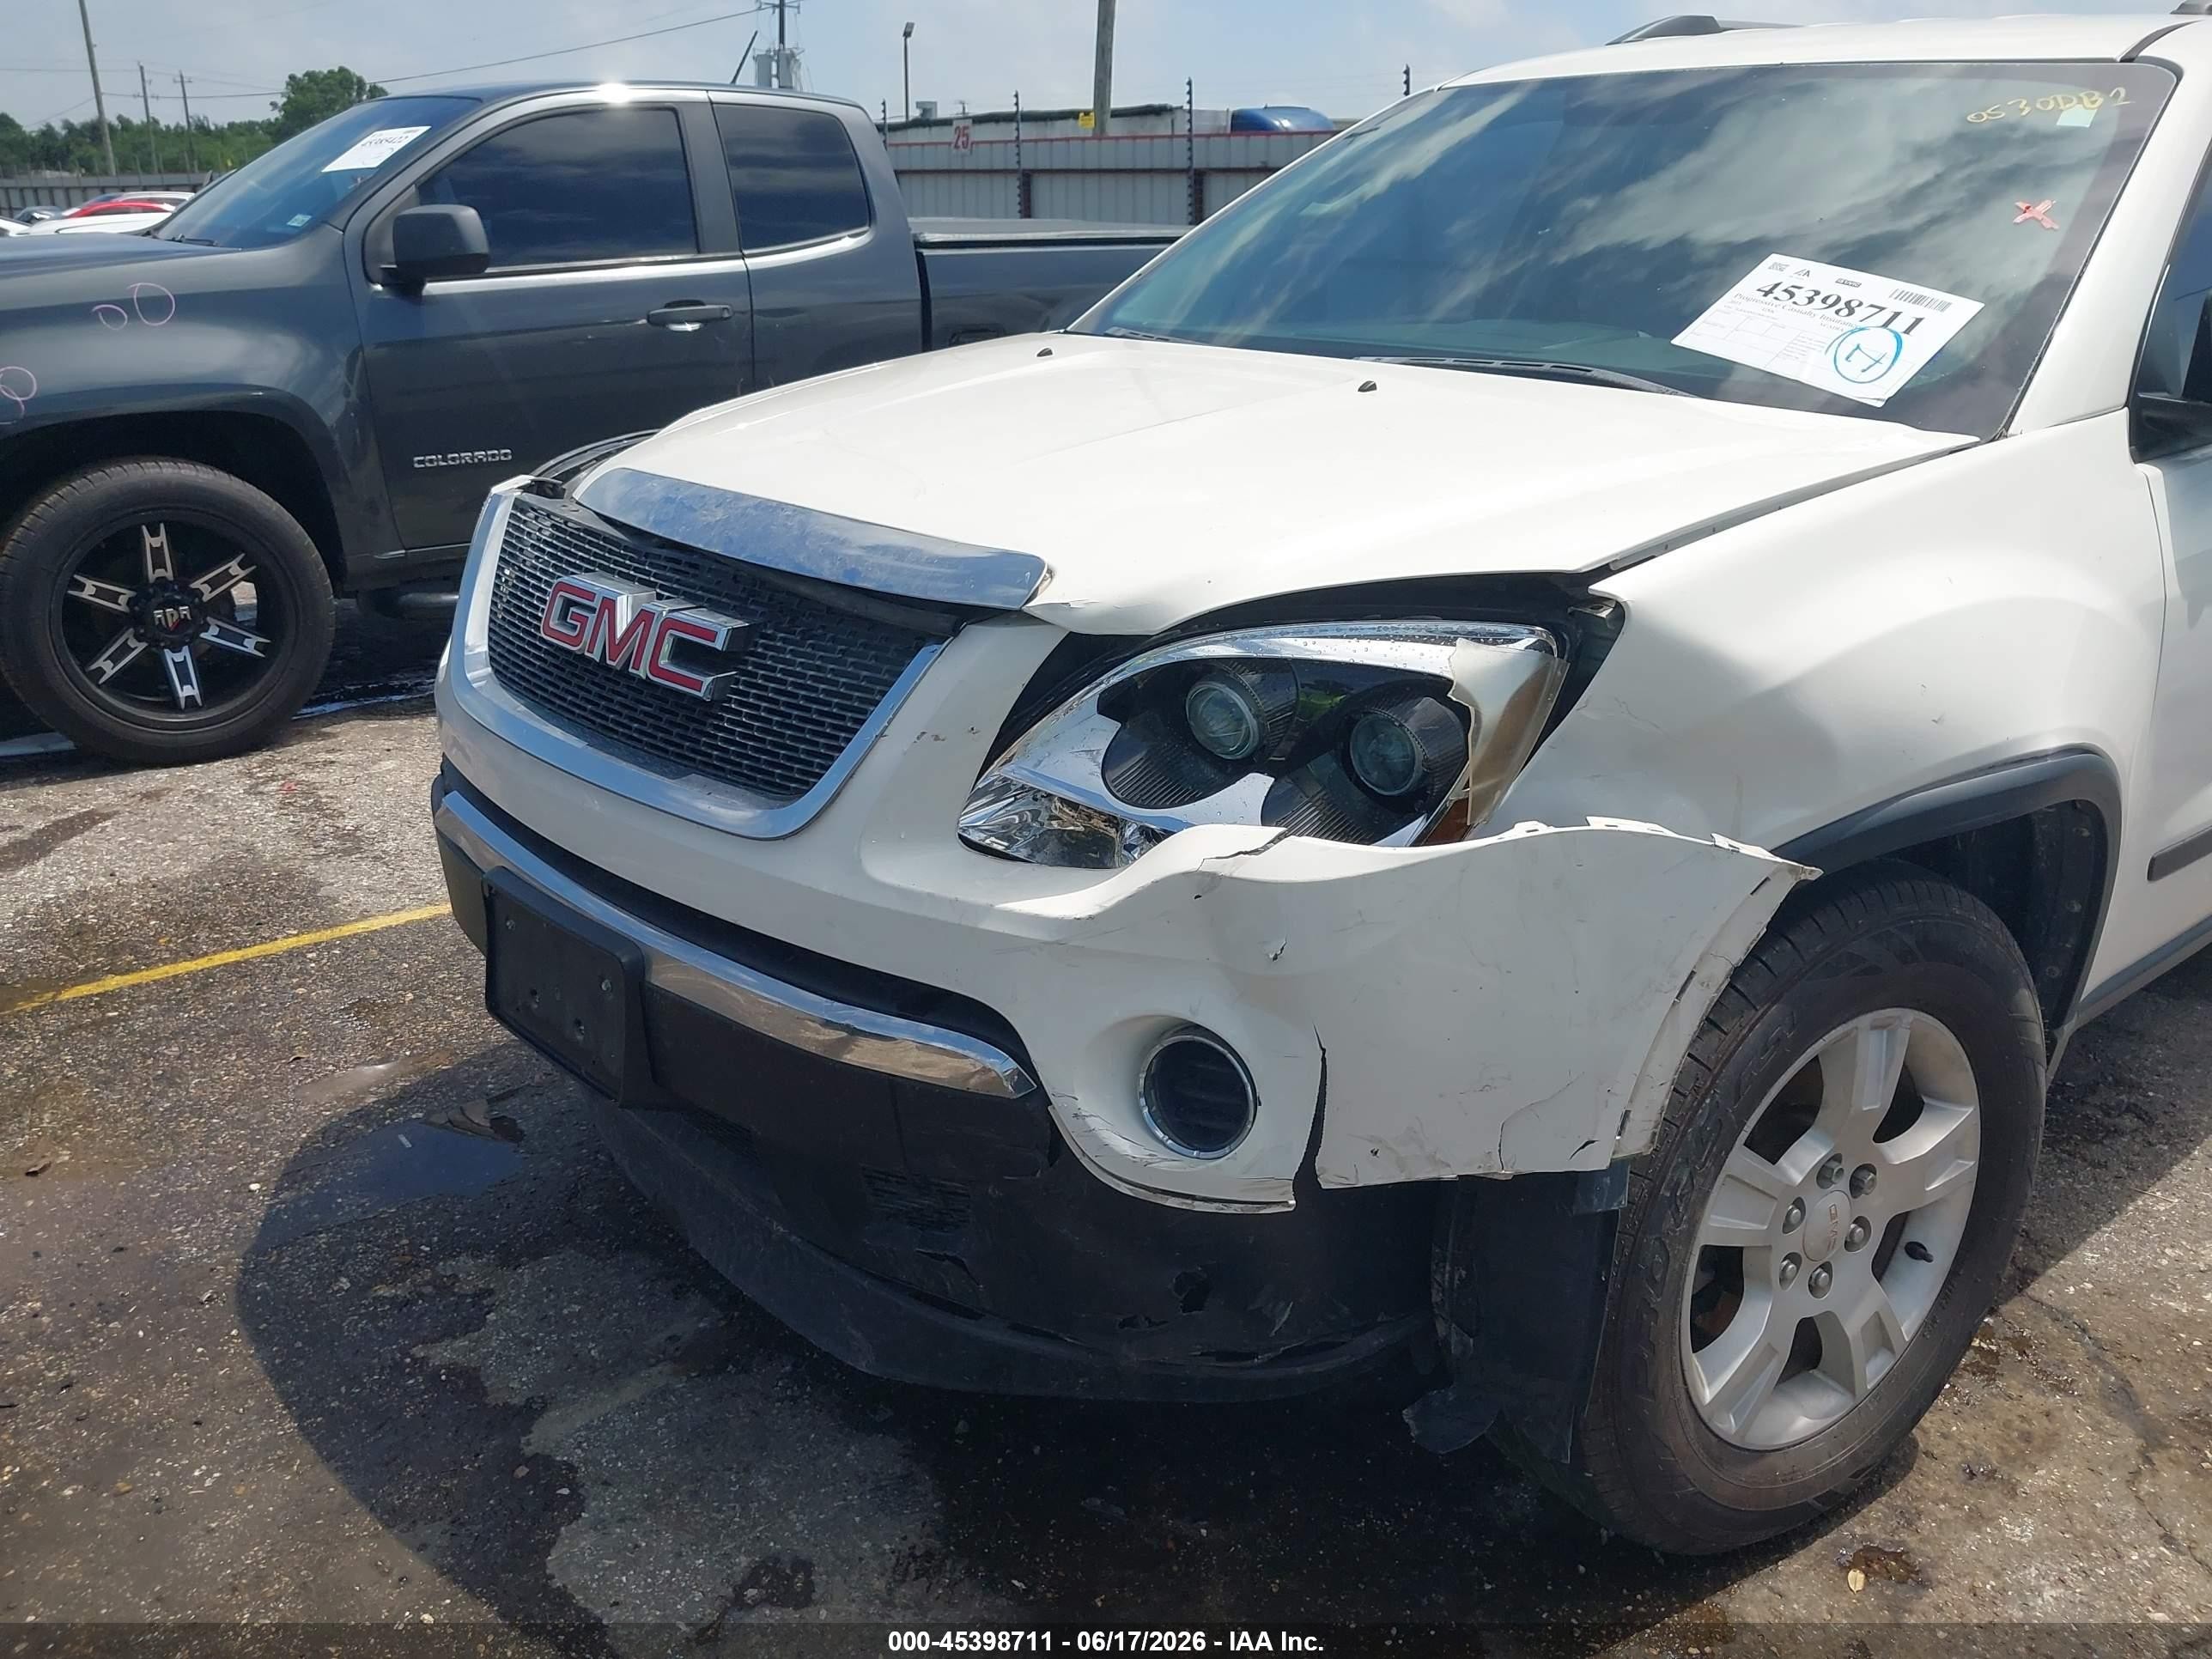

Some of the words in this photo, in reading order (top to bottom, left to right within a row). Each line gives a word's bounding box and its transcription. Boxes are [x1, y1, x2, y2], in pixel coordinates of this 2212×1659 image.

[954, 125, 969, 149] 25
[1756, 281, 1925, 337] 45398711
[413, 448, 513, 469] COLORADO
[540, 572, 750, 701] GMC
